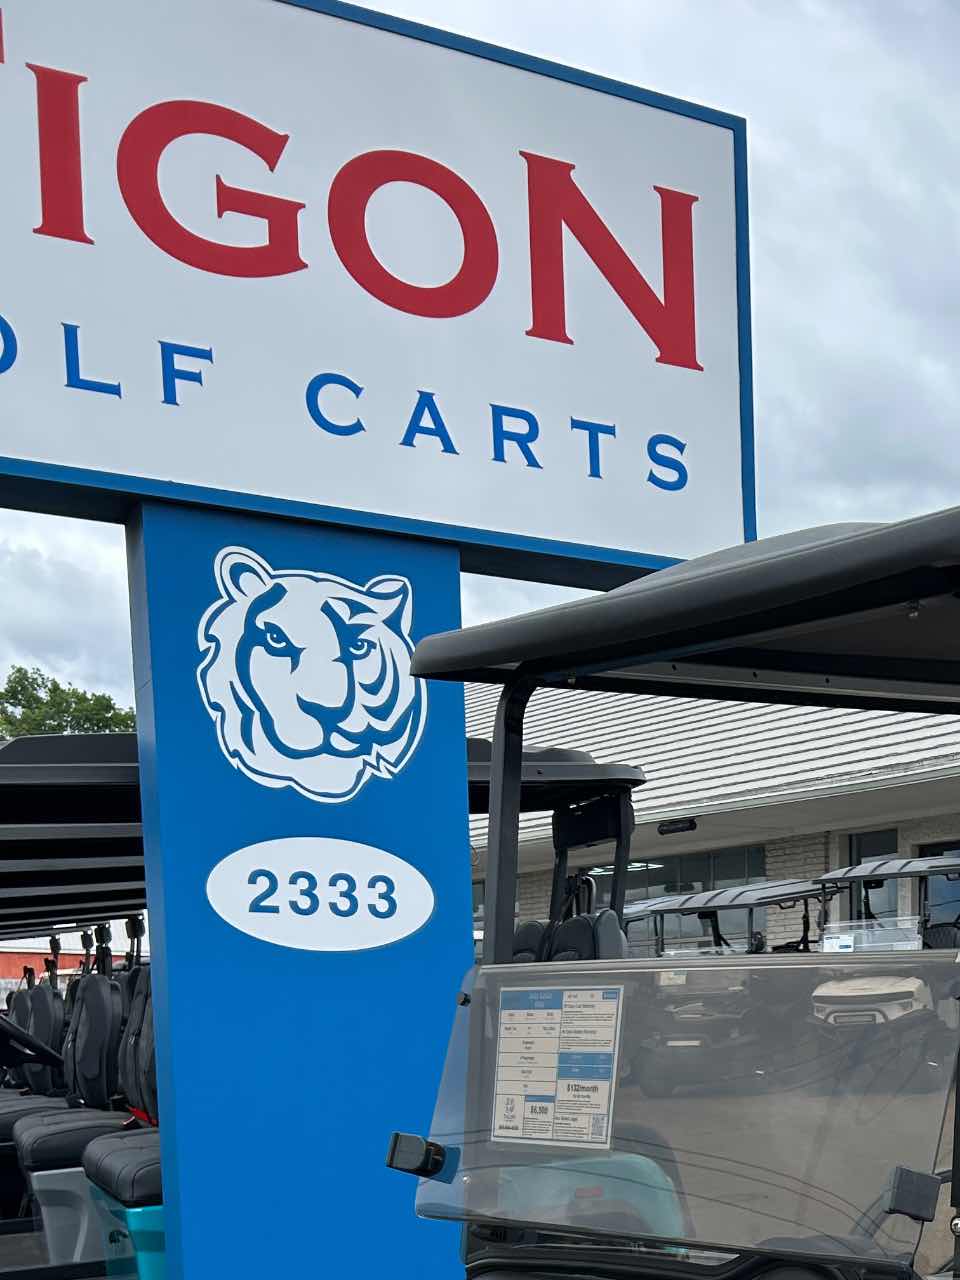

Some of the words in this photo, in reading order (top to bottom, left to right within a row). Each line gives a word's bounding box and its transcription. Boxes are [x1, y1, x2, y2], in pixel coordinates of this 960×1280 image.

[0, 7, 704, 371] IGON
[0, 314, 214, 406] LF
[305, 372, 689, 491] CARTS
[247, 869, 398, 919] 2333
